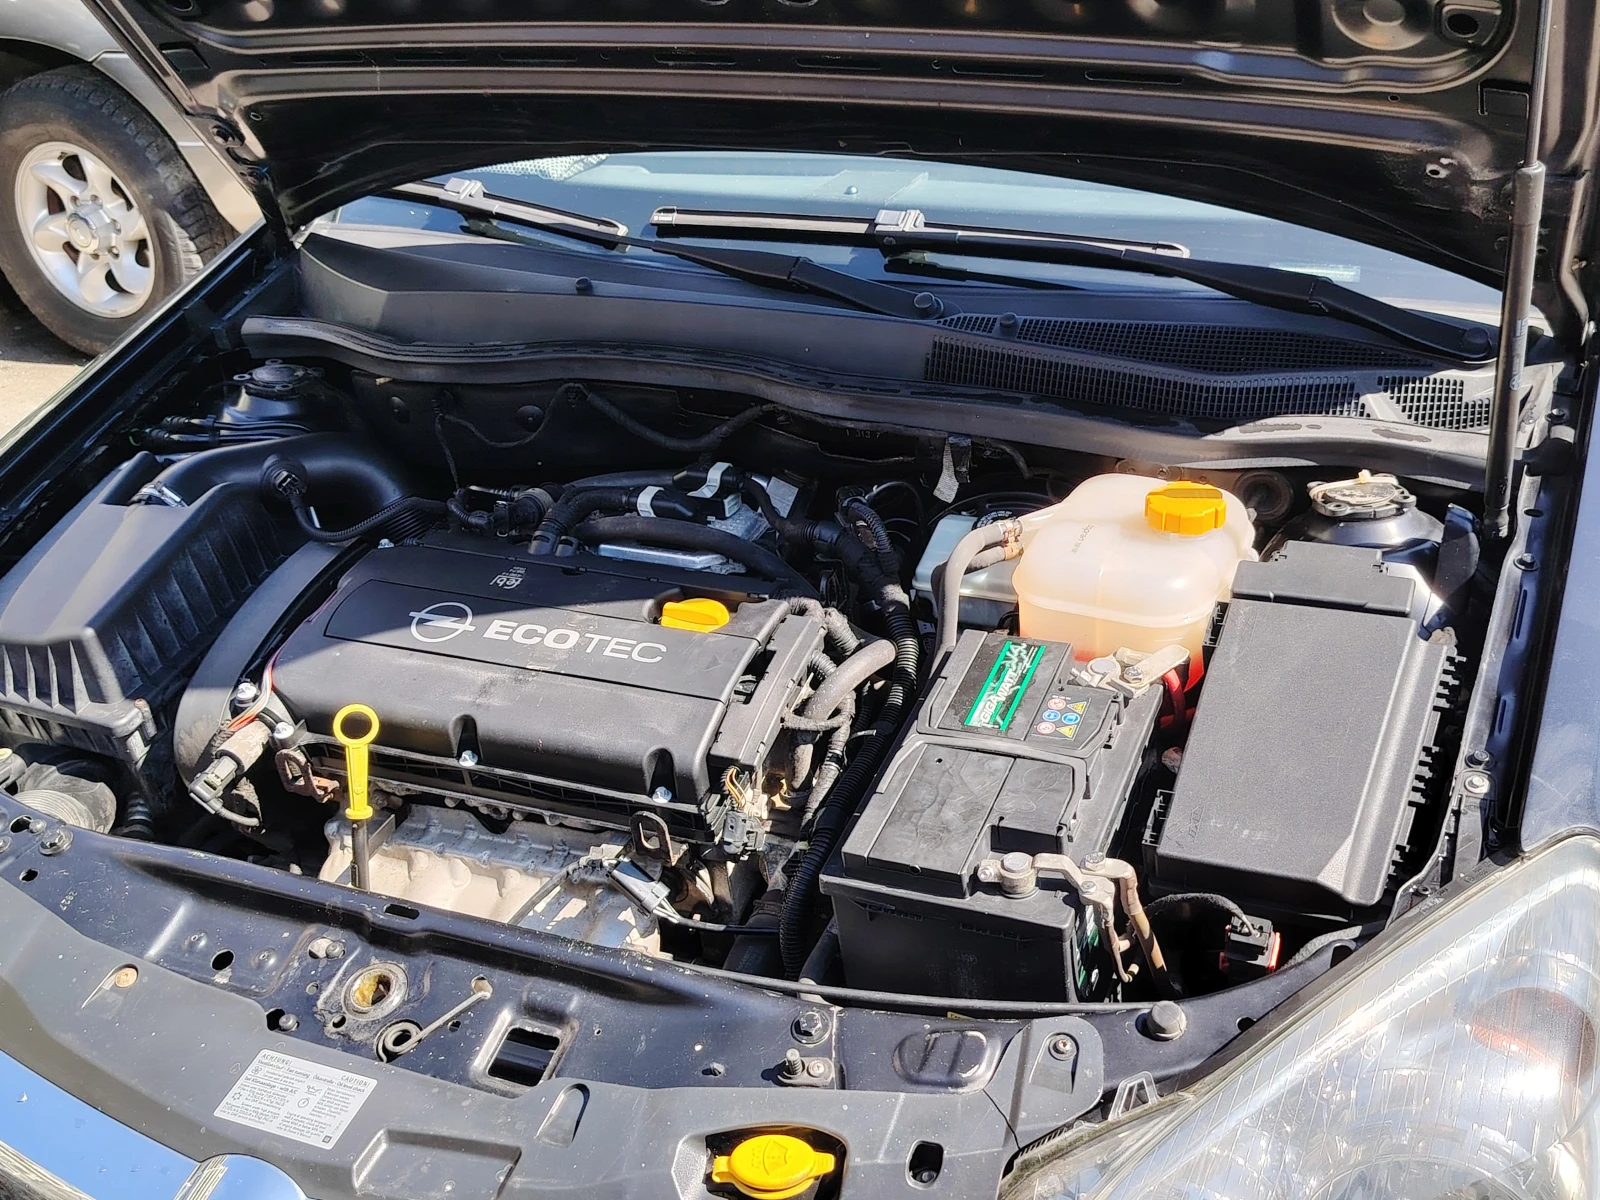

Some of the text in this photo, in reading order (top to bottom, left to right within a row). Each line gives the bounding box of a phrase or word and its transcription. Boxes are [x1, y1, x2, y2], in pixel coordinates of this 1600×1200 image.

[483, 619, 667, 663] ECOTEC
[261, 1053, 293, 1066] ACHTUNG!
[341, 1075, 371, 1088] CAUTION!
